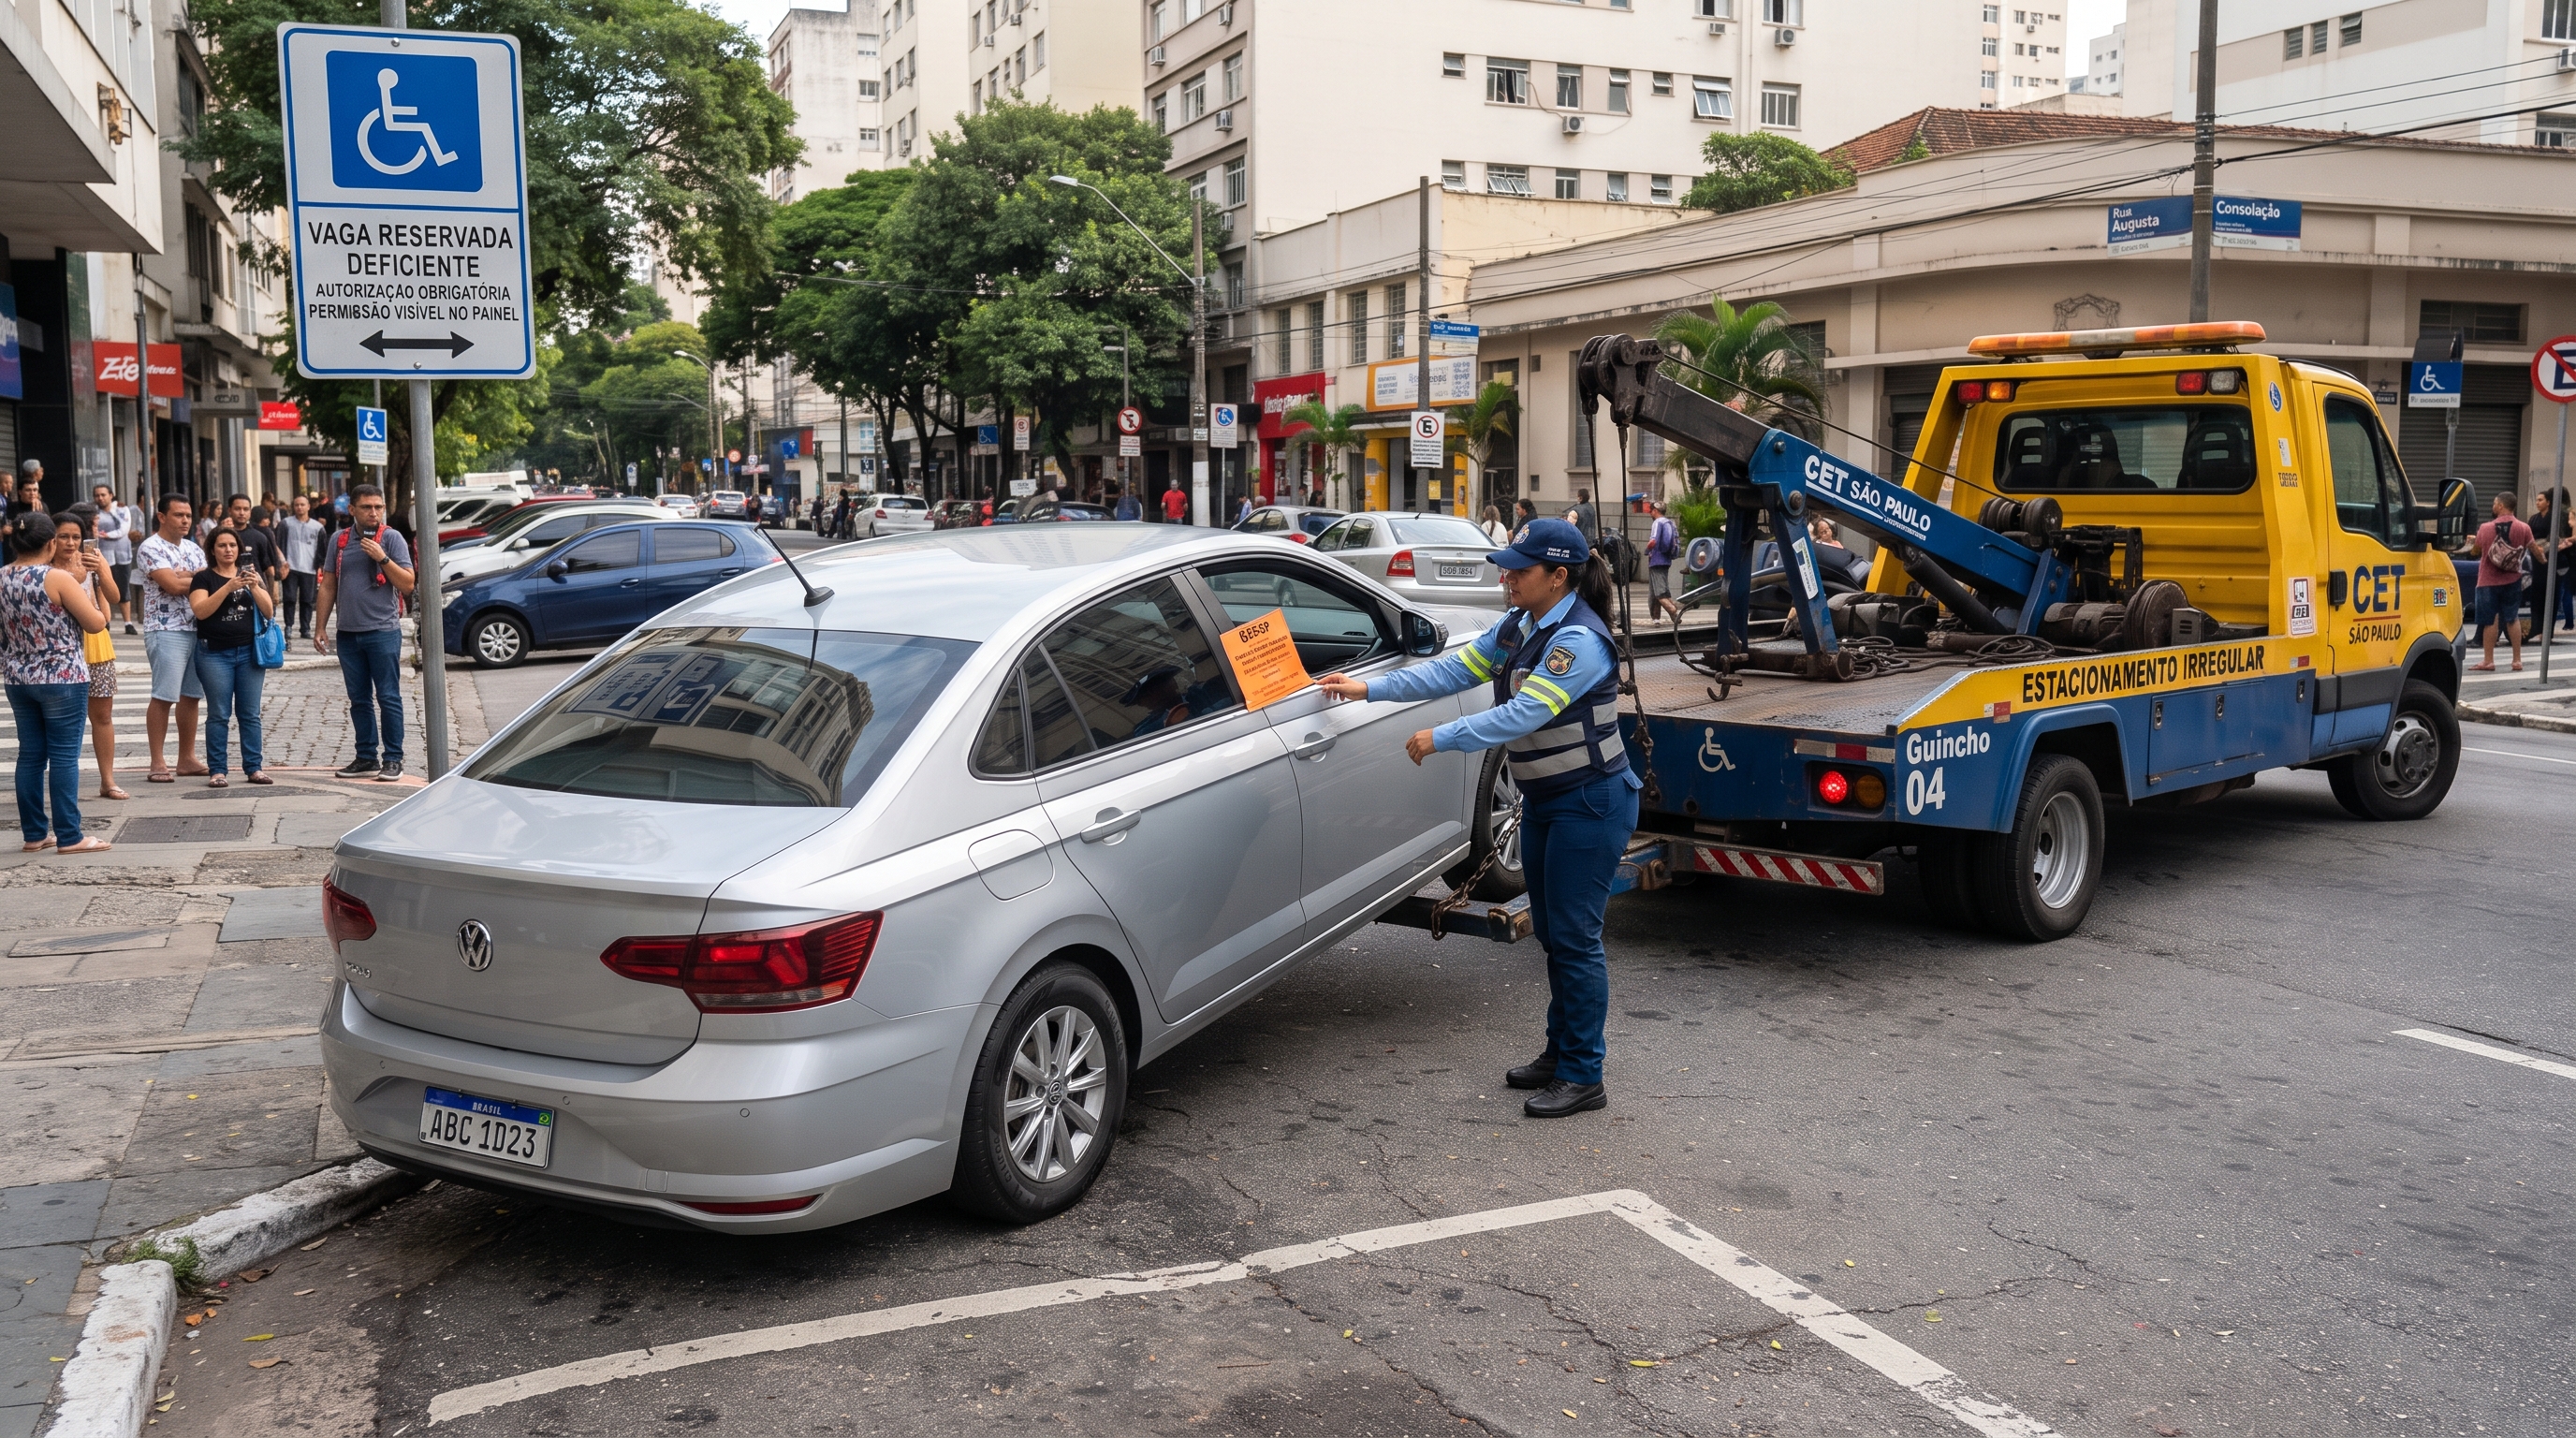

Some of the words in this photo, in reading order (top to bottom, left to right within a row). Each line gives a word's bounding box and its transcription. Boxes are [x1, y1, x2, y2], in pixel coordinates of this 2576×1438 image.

[308, 221, 373, 246] VAGA
[378, 223, 514, 249] RESERVADA
[2112, 214, 2159, 233] Augusta
[347, 253, 480, 278] DEFICIENTE
[418, 282, 511, 301] OBRIGATÓRIA
[448, 306, 468, 321] NO
[472, 306, 520, 321] PAINEL
[1805, 455, 1850, 493] CET
[1850, 480, 1881, 507] SÃO
[1884, 495, 1931, 532] PAULO
[2352, 564, 2406, 614] CET
[2370, 623, 2402, 643] PAULO
[2022, 655, 2178, 703] ESTACIONAMENTO
[2183, 645, 2265, 680] IRREGULAR
[1906, 726, 1991, 765] Guincho
[1906, 766, 1946, 815] 04
[472, 1101, 502, 1116] BRASIL
[430, 1108, 473, 1145] ABC
[478, 1120, 537, 1158] 1D23
